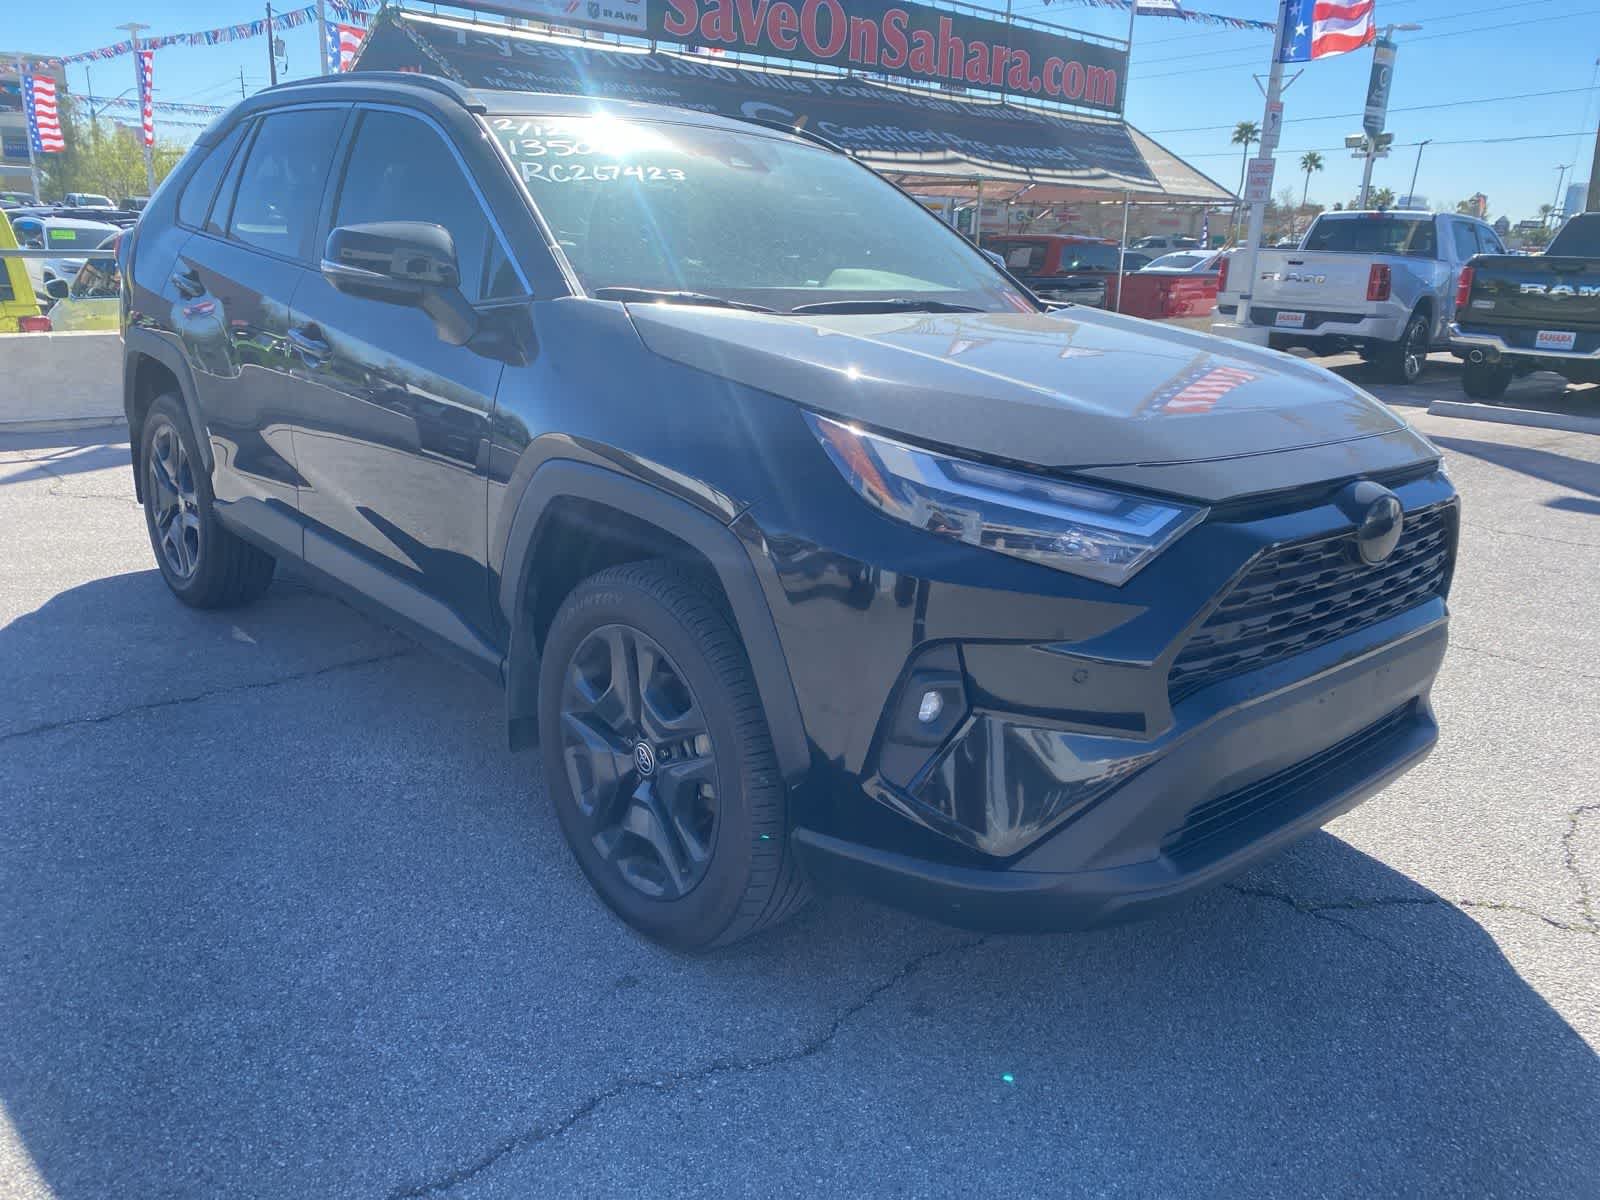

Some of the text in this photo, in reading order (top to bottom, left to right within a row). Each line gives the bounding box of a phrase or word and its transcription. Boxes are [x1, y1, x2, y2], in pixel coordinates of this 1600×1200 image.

[602, 8, 638, 21] RAM
[664, 0, 1118, 107] SaveOnSahara.com
[818, 121, 946, 144] Certified
[520, 161, 687, 183] RC267423
